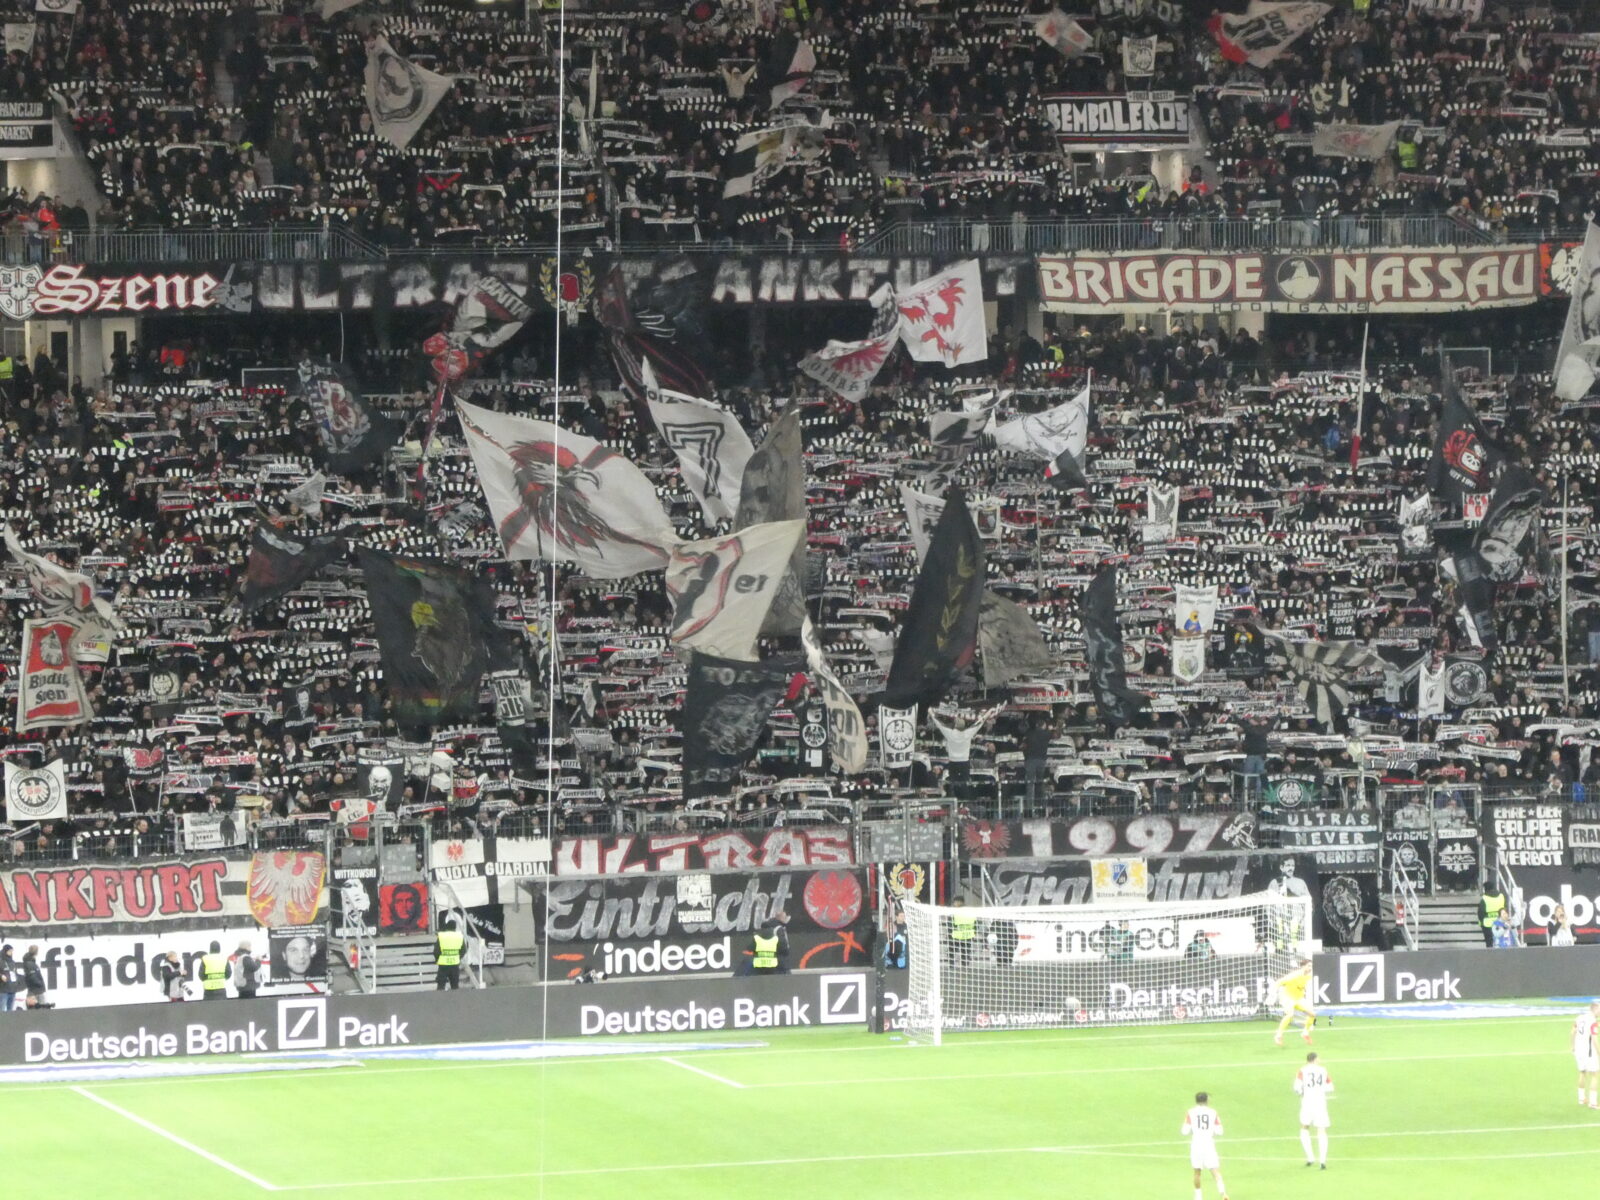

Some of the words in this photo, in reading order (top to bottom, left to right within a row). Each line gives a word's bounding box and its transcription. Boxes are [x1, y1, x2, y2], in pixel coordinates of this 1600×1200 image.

[1047, 101, 1188, 132] BEMBOLEROS
[34, 264, 221, 313] Szene
[1039, 257, 1265, 304] BRIGADE
[1333, 253, 1535, 304] NASSAU
[1212, 302, 1369, 314] HOOLIGANS
[1287, 811, 1371, 827] ULTRAS
[1494, 819, 1563, 836] GRUPPE
[556, 826, 855, 875] ULTRAS
[1021, 815, 1229, 857] 1997
[1294, 832, 1365, 846] NEVER
[1386, 831, 1429, 842] EXTREME
[1495, 836, 1564, 851] STADION
[334, 867, 377, 879] WITTKOWSKI
[435, 863, 478, 881] NUOVA
[485, 861, 547, 876] GUARDIA
[1497, 851, 1564, 866] VERBOT
[992, 855, 1249, 905] Frafurt
[1055, 919, 1180, 955] ined
[603, 936, 731, 974] indeed
[1108, 979, 1249, 1008] Deutsche
[1396, 970, 1462, 1000] Park
[580, 1001, 726, 1035] Deutsche
[733, 996, 811, 1028] Bank
[24, 1026, 178, 1062] Deutsche
[186, 1021, 268, 1054] Bank
[338, 1014, 410, 1046] Park
[1307, 1072, 1324, 1088] 34
[1197, 1113, 1210, 1131] 19
